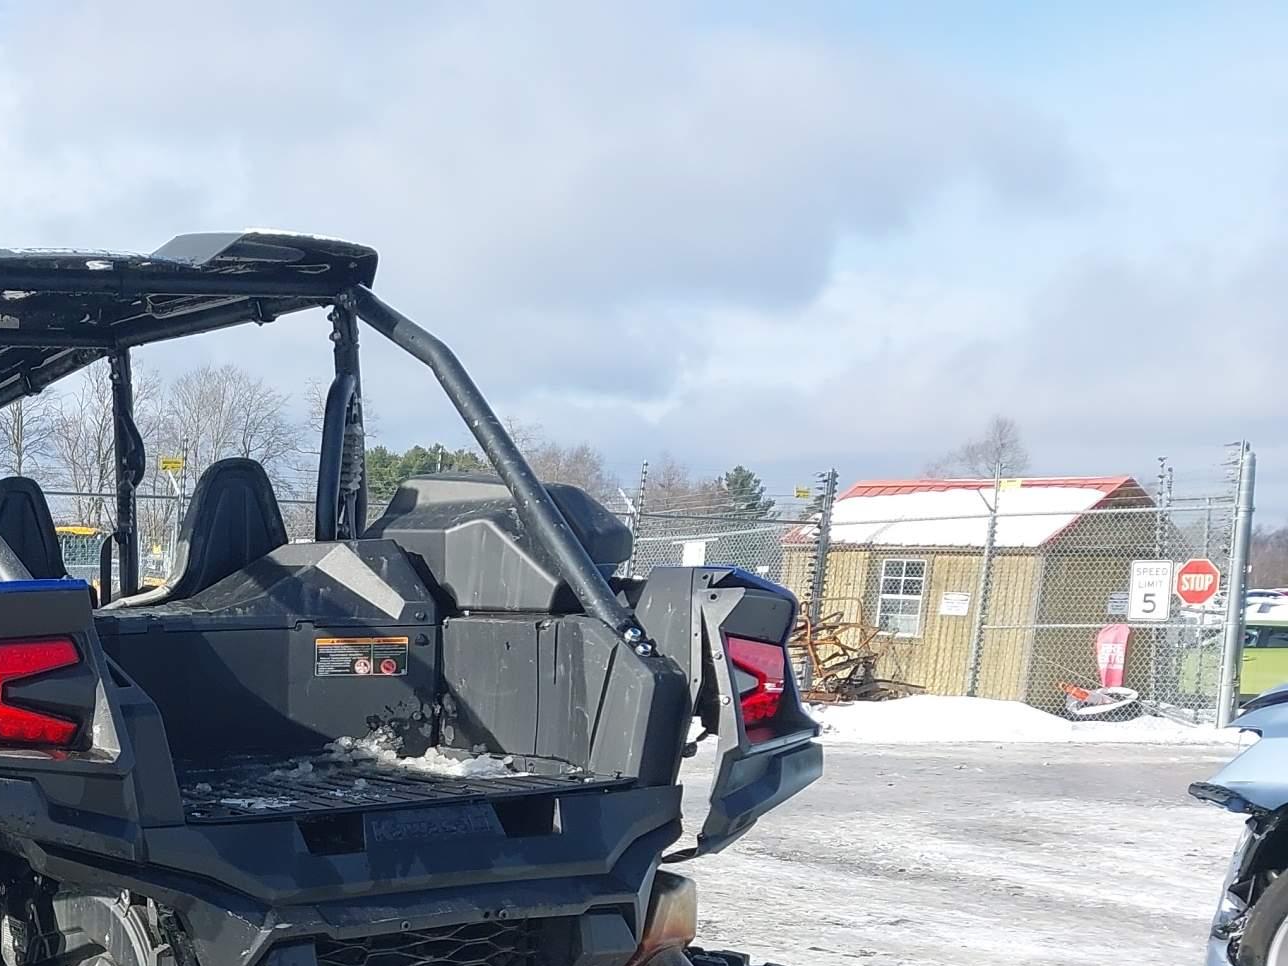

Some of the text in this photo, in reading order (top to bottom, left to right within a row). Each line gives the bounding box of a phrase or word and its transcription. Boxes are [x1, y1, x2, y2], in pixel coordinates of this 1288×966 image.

[1136, 567, 1168, 576] SPEED
[1138, 580, 1163, 589] LIMIT
[1181, 573, 1214, 592] STOP
[1142, 593, 1156, 614] 5
